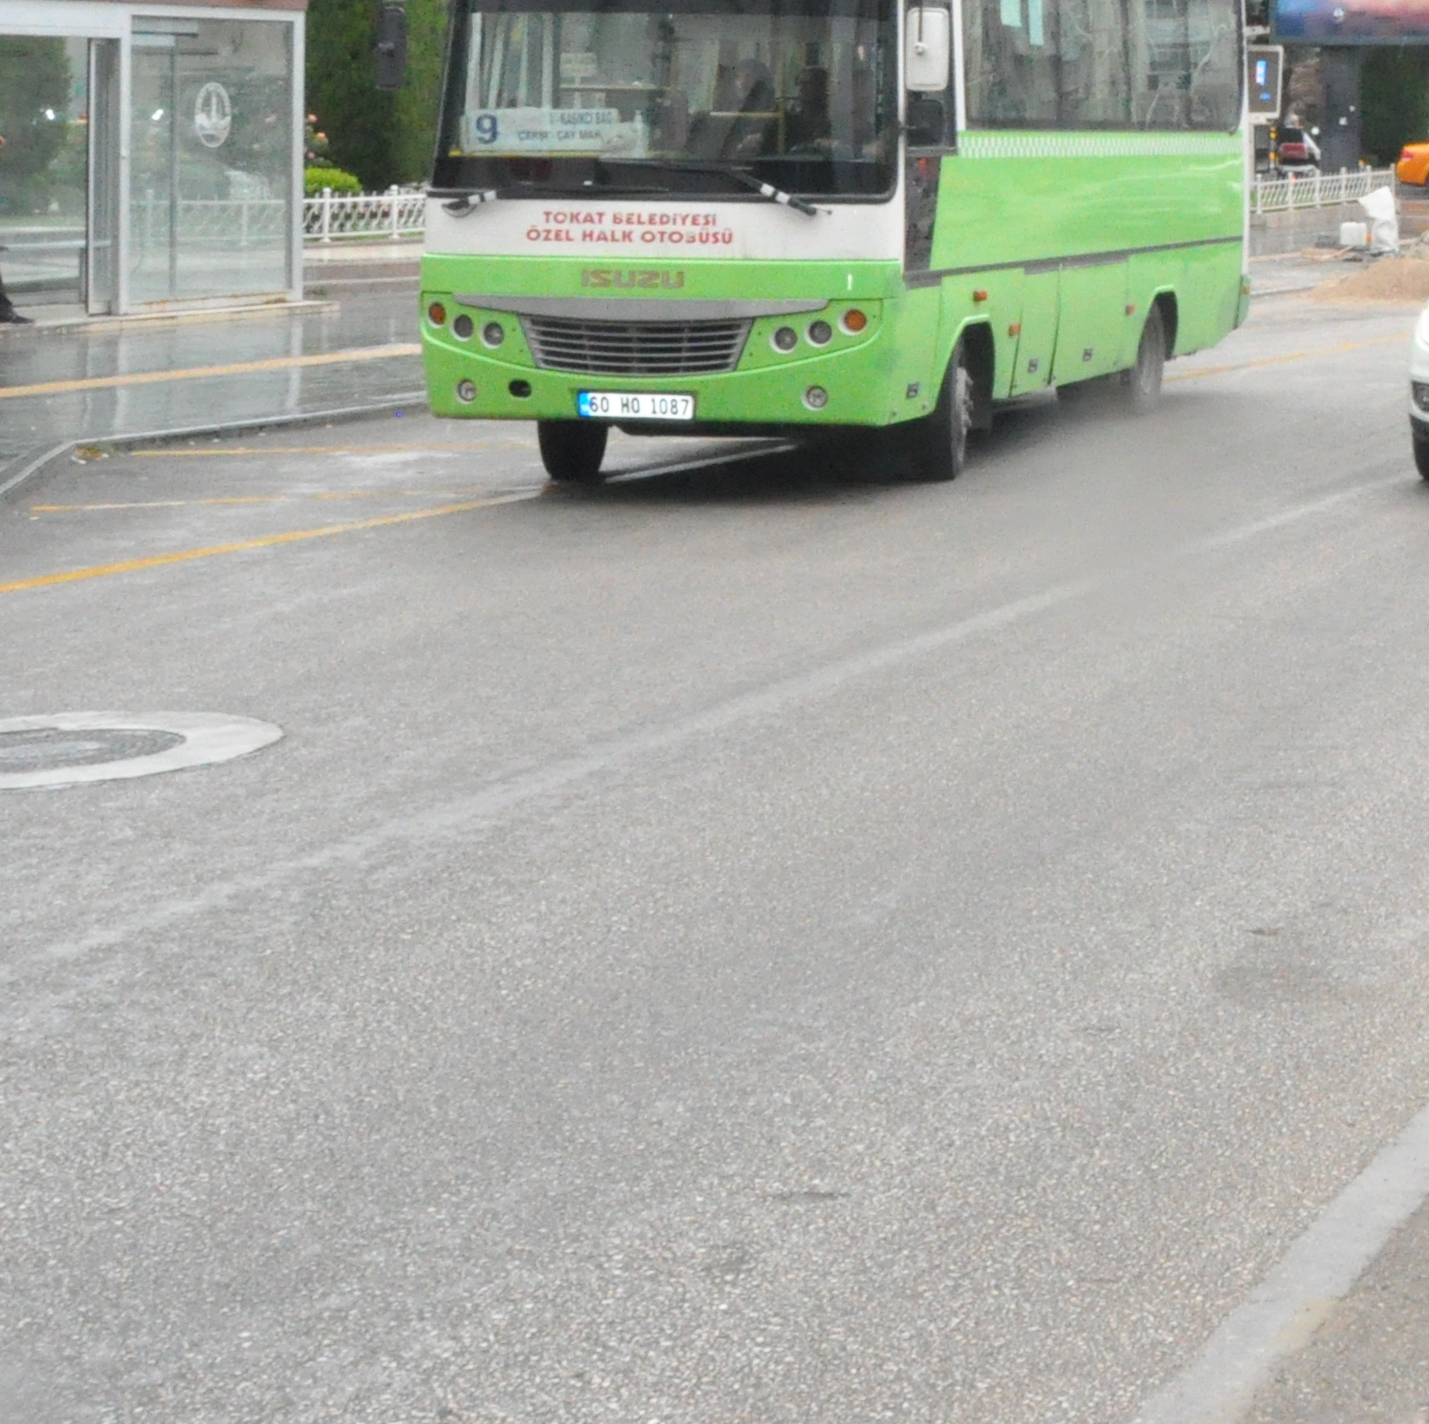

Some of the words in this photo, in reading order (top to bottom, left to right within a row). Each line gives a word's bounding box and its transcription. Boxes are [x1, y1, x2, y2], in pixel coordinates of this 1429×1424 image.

[475, 113, 498, 144] 9
[543, 211, 605, 225] TOKAT
[612, 212, 717, 226] BELEDİYESİ
[526, 225, 574, 242] ÖZEL
[581, 230, 633, 243] HALK
[641, 227, 734, 244] OTOBÜSÜ
[581, 268, 685, 289] ISUZU
[589, 396, 609, 412] 60
[651, 398, 690, 416] 1087
